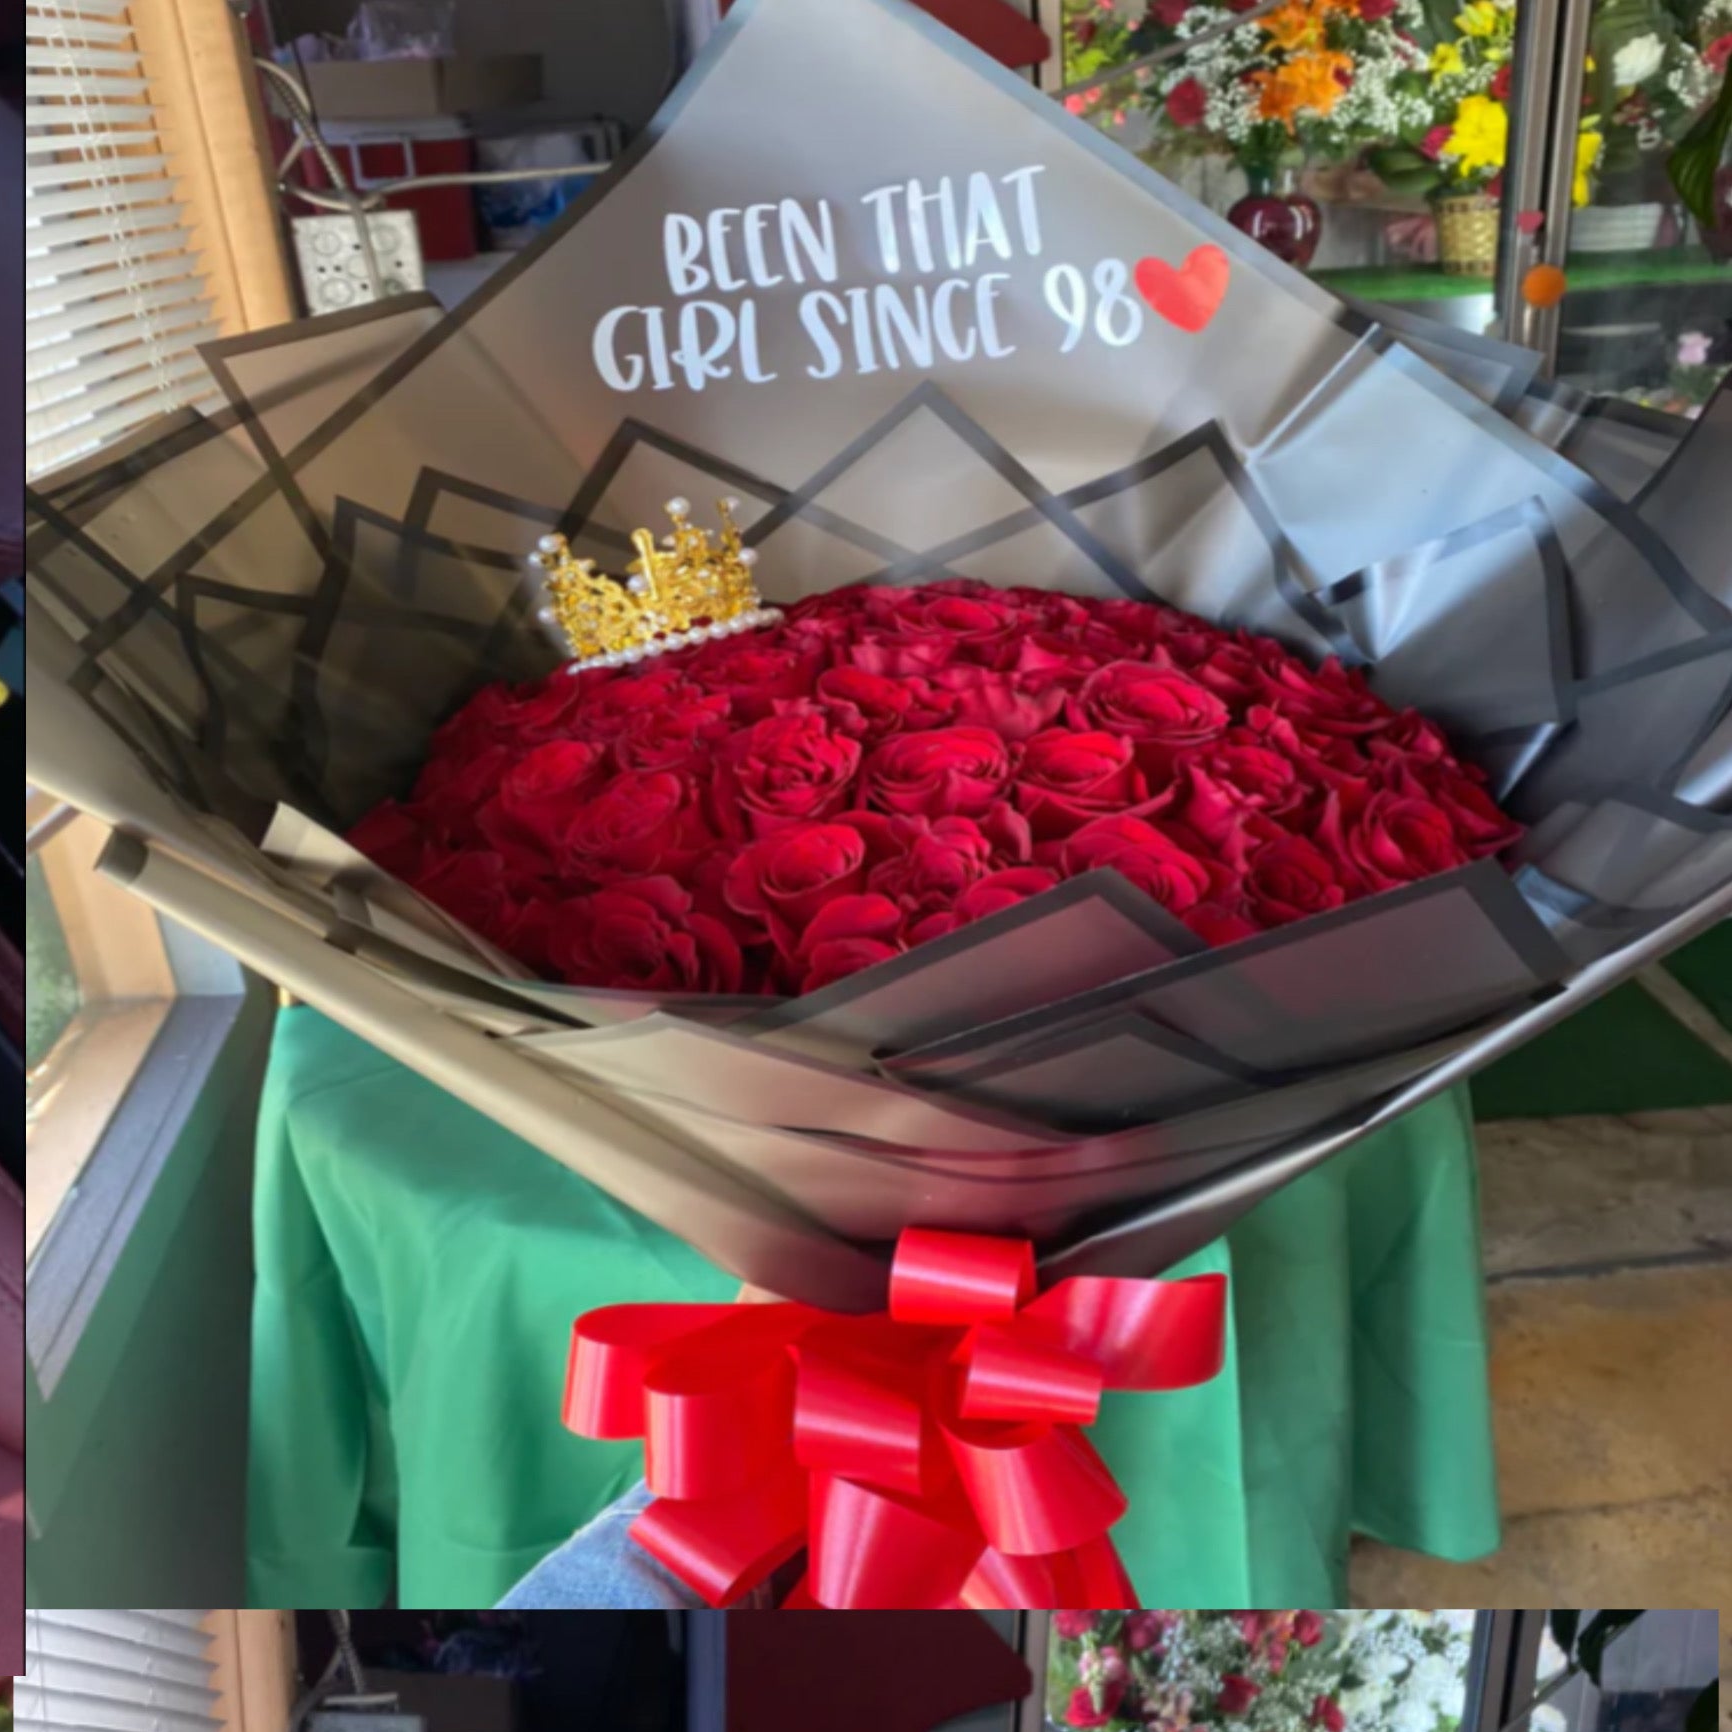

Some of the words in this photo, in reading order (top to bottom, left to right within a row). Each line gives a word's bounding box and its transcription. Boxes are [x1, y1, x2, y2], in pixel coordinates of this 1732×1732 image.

[663, 198, 838, 296] BEEN
[861, 164, 1046, 275] THAT
[592, 299, 778, 393] GIRL
[798, 272, 1017, 380] SINCE
[1043, 258, 1144, 355] 98
